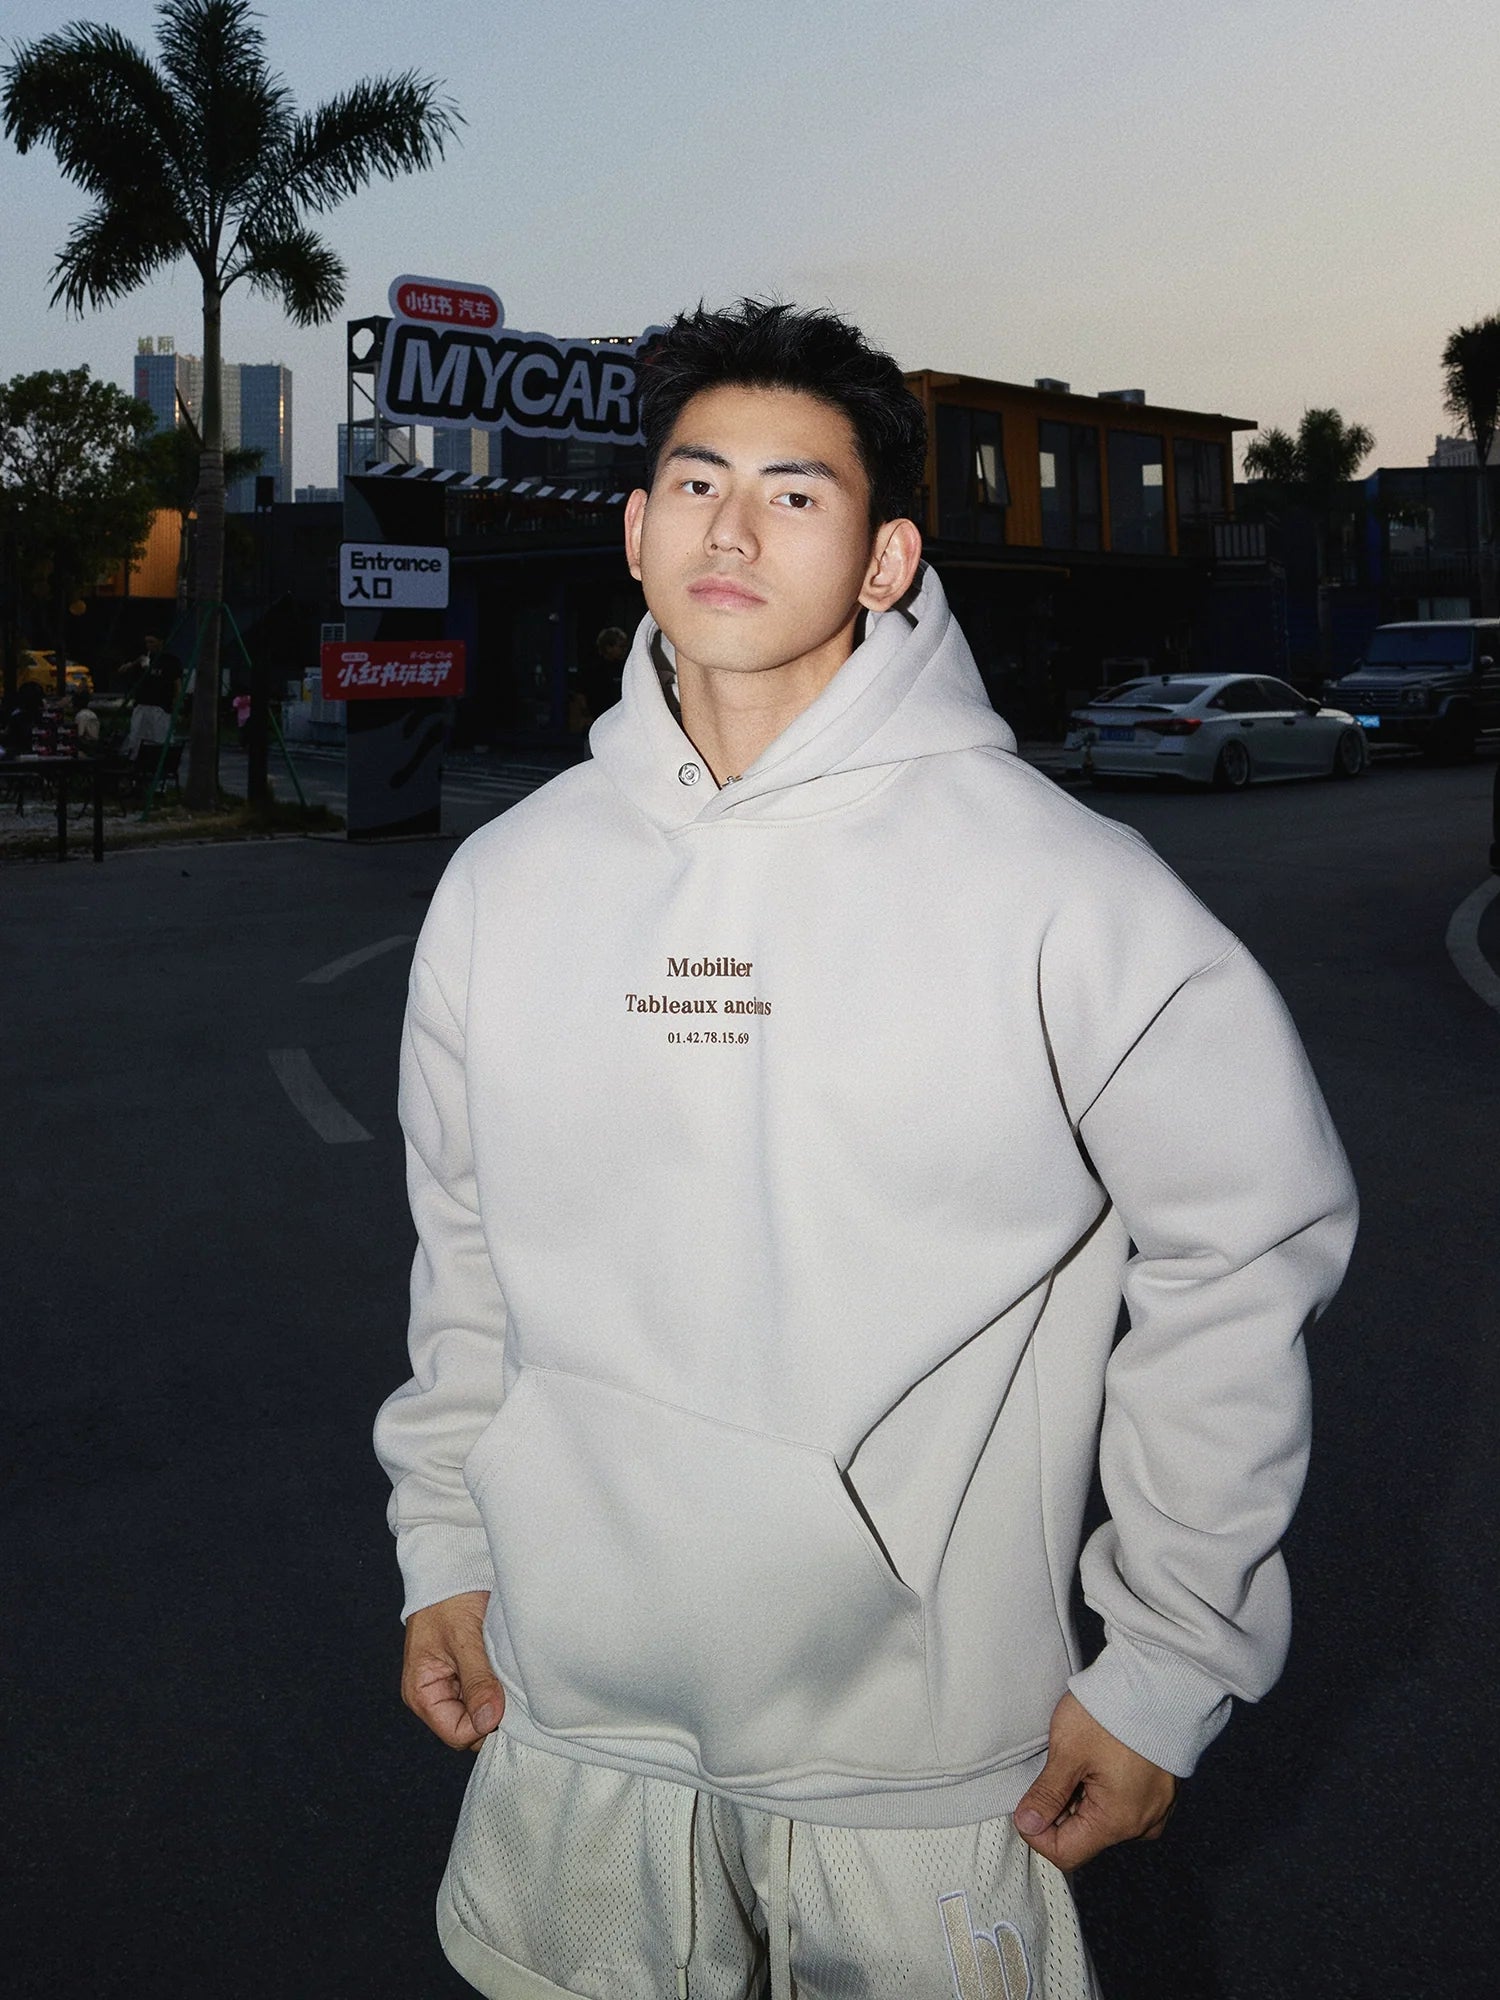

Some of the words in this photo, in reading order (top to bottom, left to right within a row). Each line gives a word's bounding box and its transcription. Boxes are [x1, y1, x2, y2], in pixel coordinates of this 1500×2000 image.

[405, 291, 454, 316] 小红书
[459, 298, 492, 321] 汽车
[397, 338, 637, 424] MYCAR
[350, 551, 442, 573] Entrance
[347, 575, 393, 600] 入口
[666, 957, 753, 978] Mobilier
[625, 993, 718, 1014] Tableaux
[667, 1031, 750, 1045] 01.42.78.15.69
